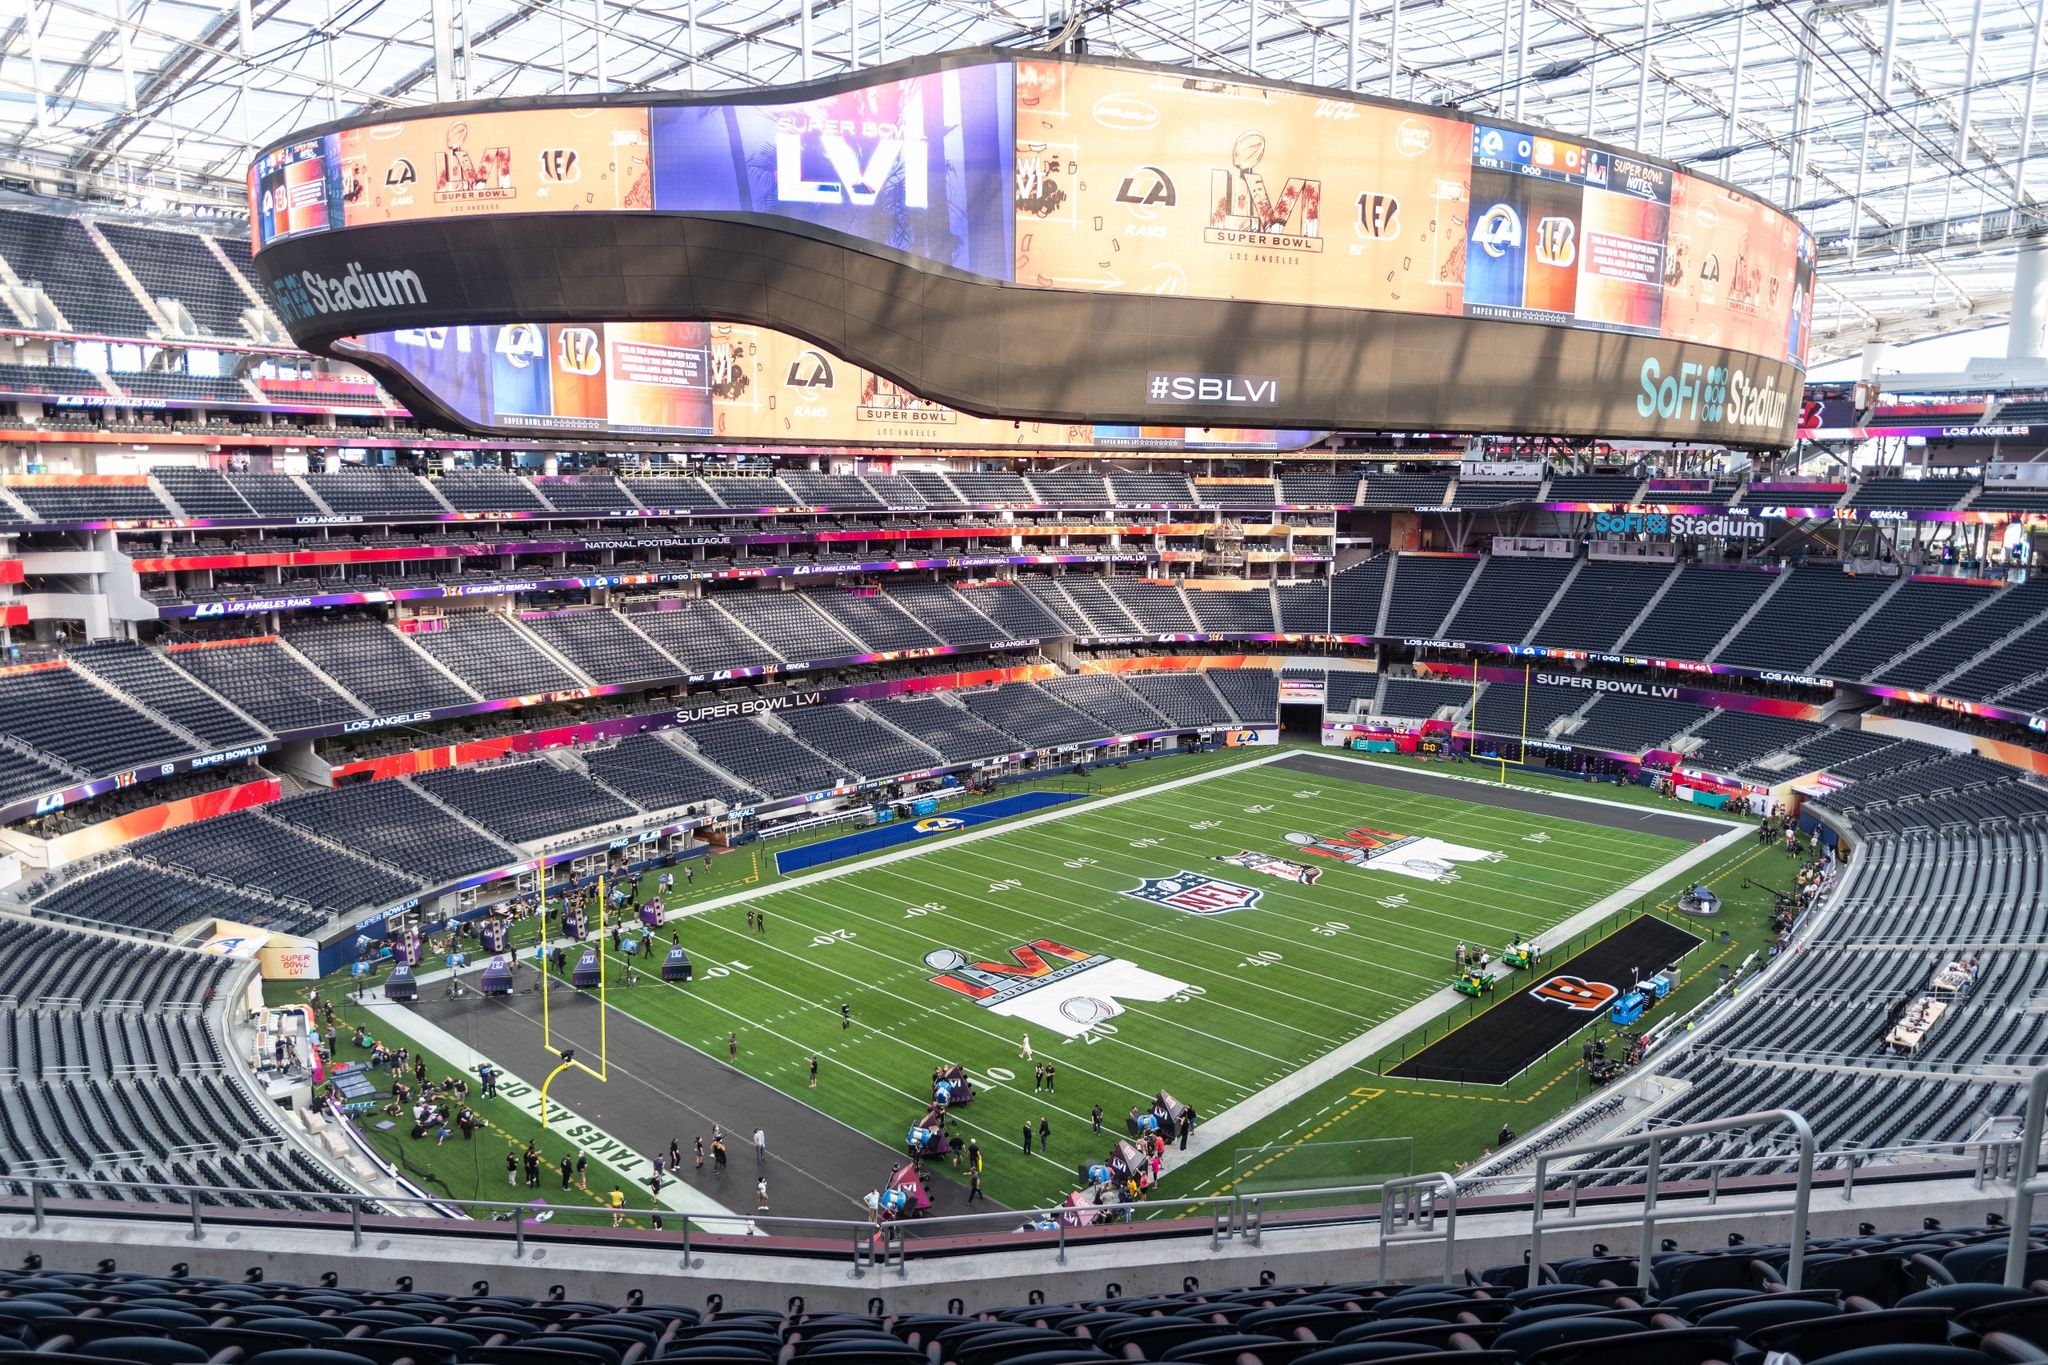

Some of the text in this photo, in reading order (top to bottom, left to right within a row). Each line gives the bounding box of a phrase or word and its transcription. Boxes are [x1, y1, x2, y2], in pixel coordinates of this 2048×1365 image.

[777, 116, 855, 136] SUPER
[1518, 141, 1578, 167] 0 0
[776, 133, 929, 209] LVI
[1480, 159, 1497, 168] QTR
[1614, 159, 1664, 185] SUPER BOWL
[1626, 178, 1653, 194] NOTES
[442, 190, 507, 200] SUPER BOWL
[1217, 232, 1312, 249] SUPER BOWL
[1230, 252, 1300, 265] LOS ANGELES
[302, 262, 427, 315] Stadium
[1472, 306, 1493, 315] SUPER
[1150, 376, 1277, 403] #SBLVI
[1636, 357, 1788, 429] SoFi Stadium
[88, 397, 167, 409] LOS ANGELES RAMS
[504, 417, 523, 425] SUPER
[866, 410, 947, 422] SUPER BOWL
[1943, 426, 2029, 436] LOS ANGELES
[1728, 507, 1749, 515] RAMS
[1870, 511, 1908, 519] BENGALS
[296, 515, 364, 524] LOS ANGELES
[1596, 513, 1765, 537] SoFi Stadium
[585, 536, 731, 550] NATIONAL FOOTBALL LEAGUE
[466, 584, 504, 594] CINCINNATI
[505, 582, 537, 591] BENGALS
[823, 565, 846, 573] ANGELES
[962, 558, 987, 566] CINCINNATI
[228, 598, 311, 612] LOS ANGELES RAMS
[989, 638, 1040, 648] LOS ANGELES
[1422, 640, 1466, 649] ANGELES
[1760, 671, 1782, 681] LOS
[1783, 673, 1834, 687] ANGELES
[689, 673, 704, 682] RAMS
[786, 662, 810, 671] BENGALS
[1536, 673, 1678, 698] SUPER BOWL LVI
[676, 692, 821, 723] SUPER BOWL LVI
[344, 711, 431, 732] LOS ANGELES
[191, 745, 267, 768] SUPER BOWL LVI
[610, 839, 629, 849] RAMS
[728, 808, 755, 819] BENGALS
[1189, 820, 1219, 830] 30
[1130, 838, 1158, 849] 40
[1063, 856, 1098, 869] 50
[989, 878, 1022, 892] 40
[1166, 885, 1254, 911] NFL
[1376, 894, 1409, 908] 40
[355, 899, 419, 931] SUPER BOWL LVI
[907, 902, 947, 917] 30
[813, 929, 857, 945] 20
[1316, 921, 1351, 937] 50
[1246, 951, 1283, 967] 40
[289, 967, 303, 975] LVI
[707, 960, 753, 978] 10
[928, 939, 1094, 1001] LVI
[991, 958, 1098, 1001] SUPER BOWL
[1081, 1022, 1119, 1045] 20
[966, 1067, 1016, 1092] 10
[1154, 1108, 1168, 1119] LVI
[496, 1080, 646, 1173] TAKES ALL OF
[1113, 1157, 1126, 1172] LVI
